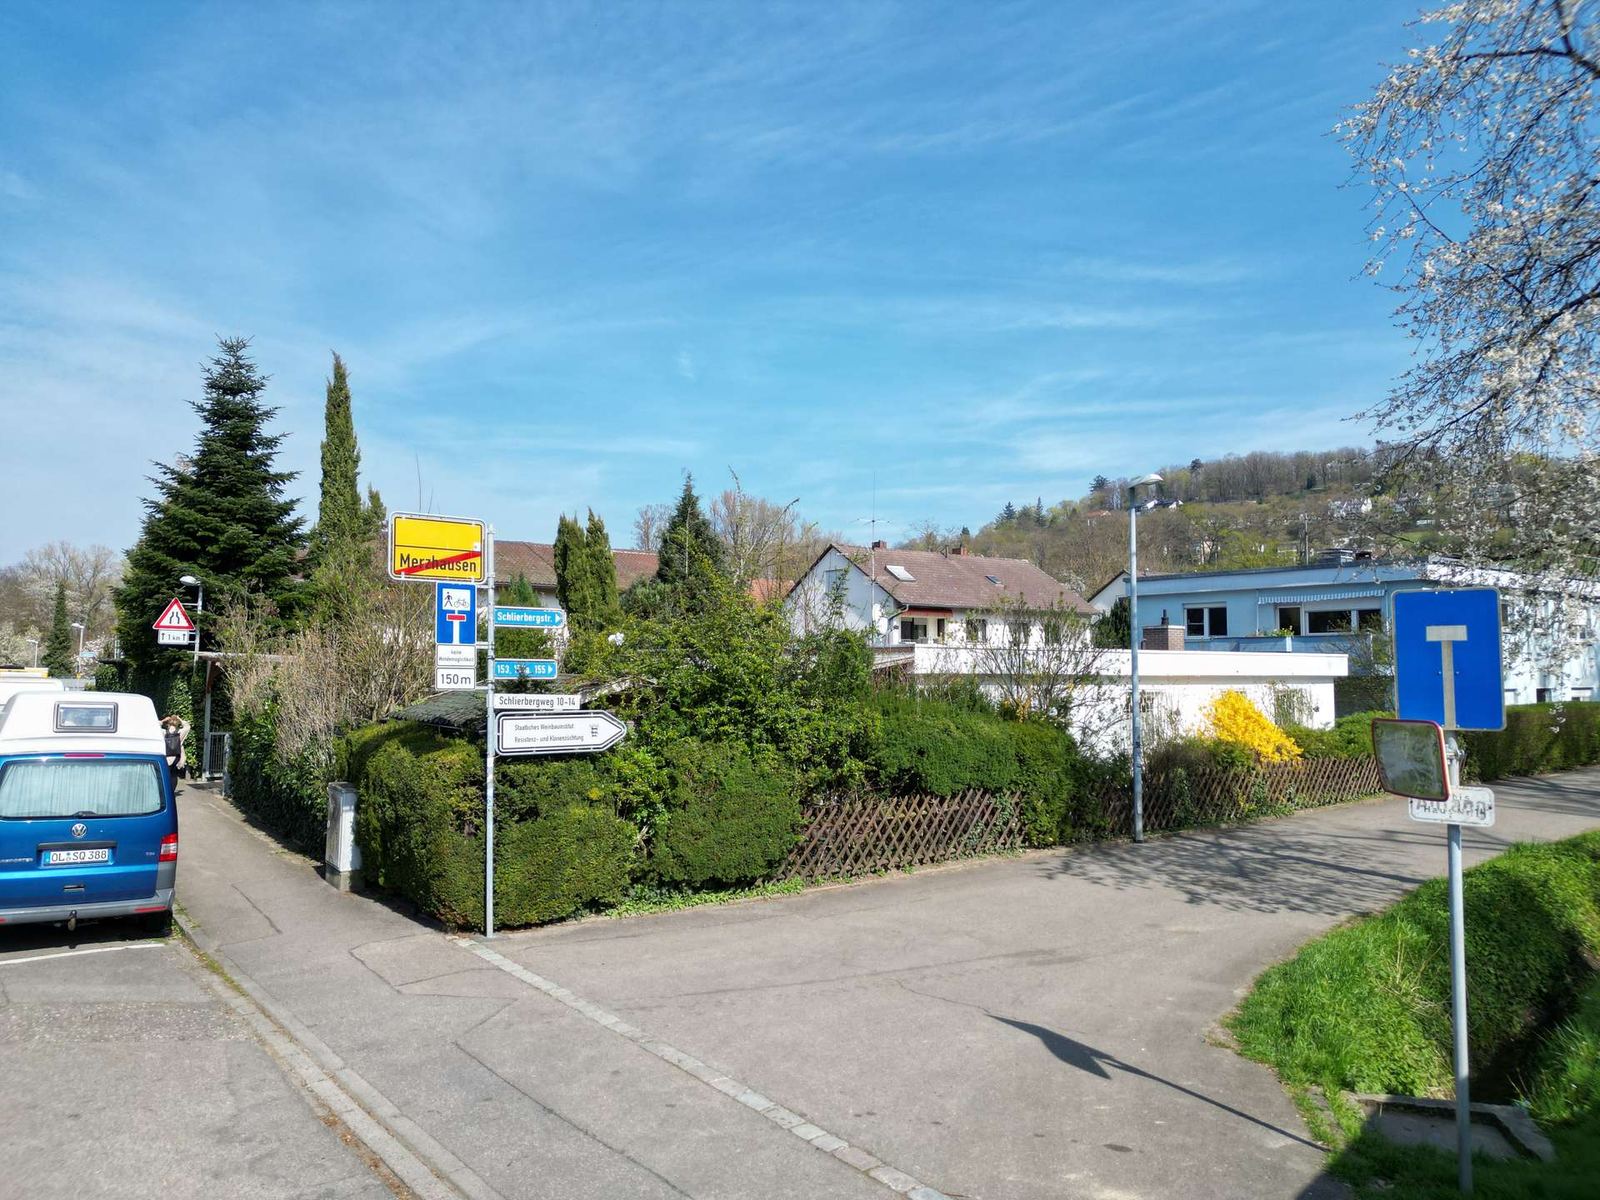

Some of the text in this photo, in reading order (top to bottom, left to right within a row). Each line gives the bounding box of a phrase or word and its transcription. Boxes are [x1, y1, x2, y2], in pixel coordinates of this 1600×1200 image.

[400, 553, 477, 573] Merzhausen
[497, 611, 553, 625] Schlierbergstr.
[499, 695, 576, 708] Schlierbergweg 10-14
[51, 850, 107, 862] OL SQ 388
